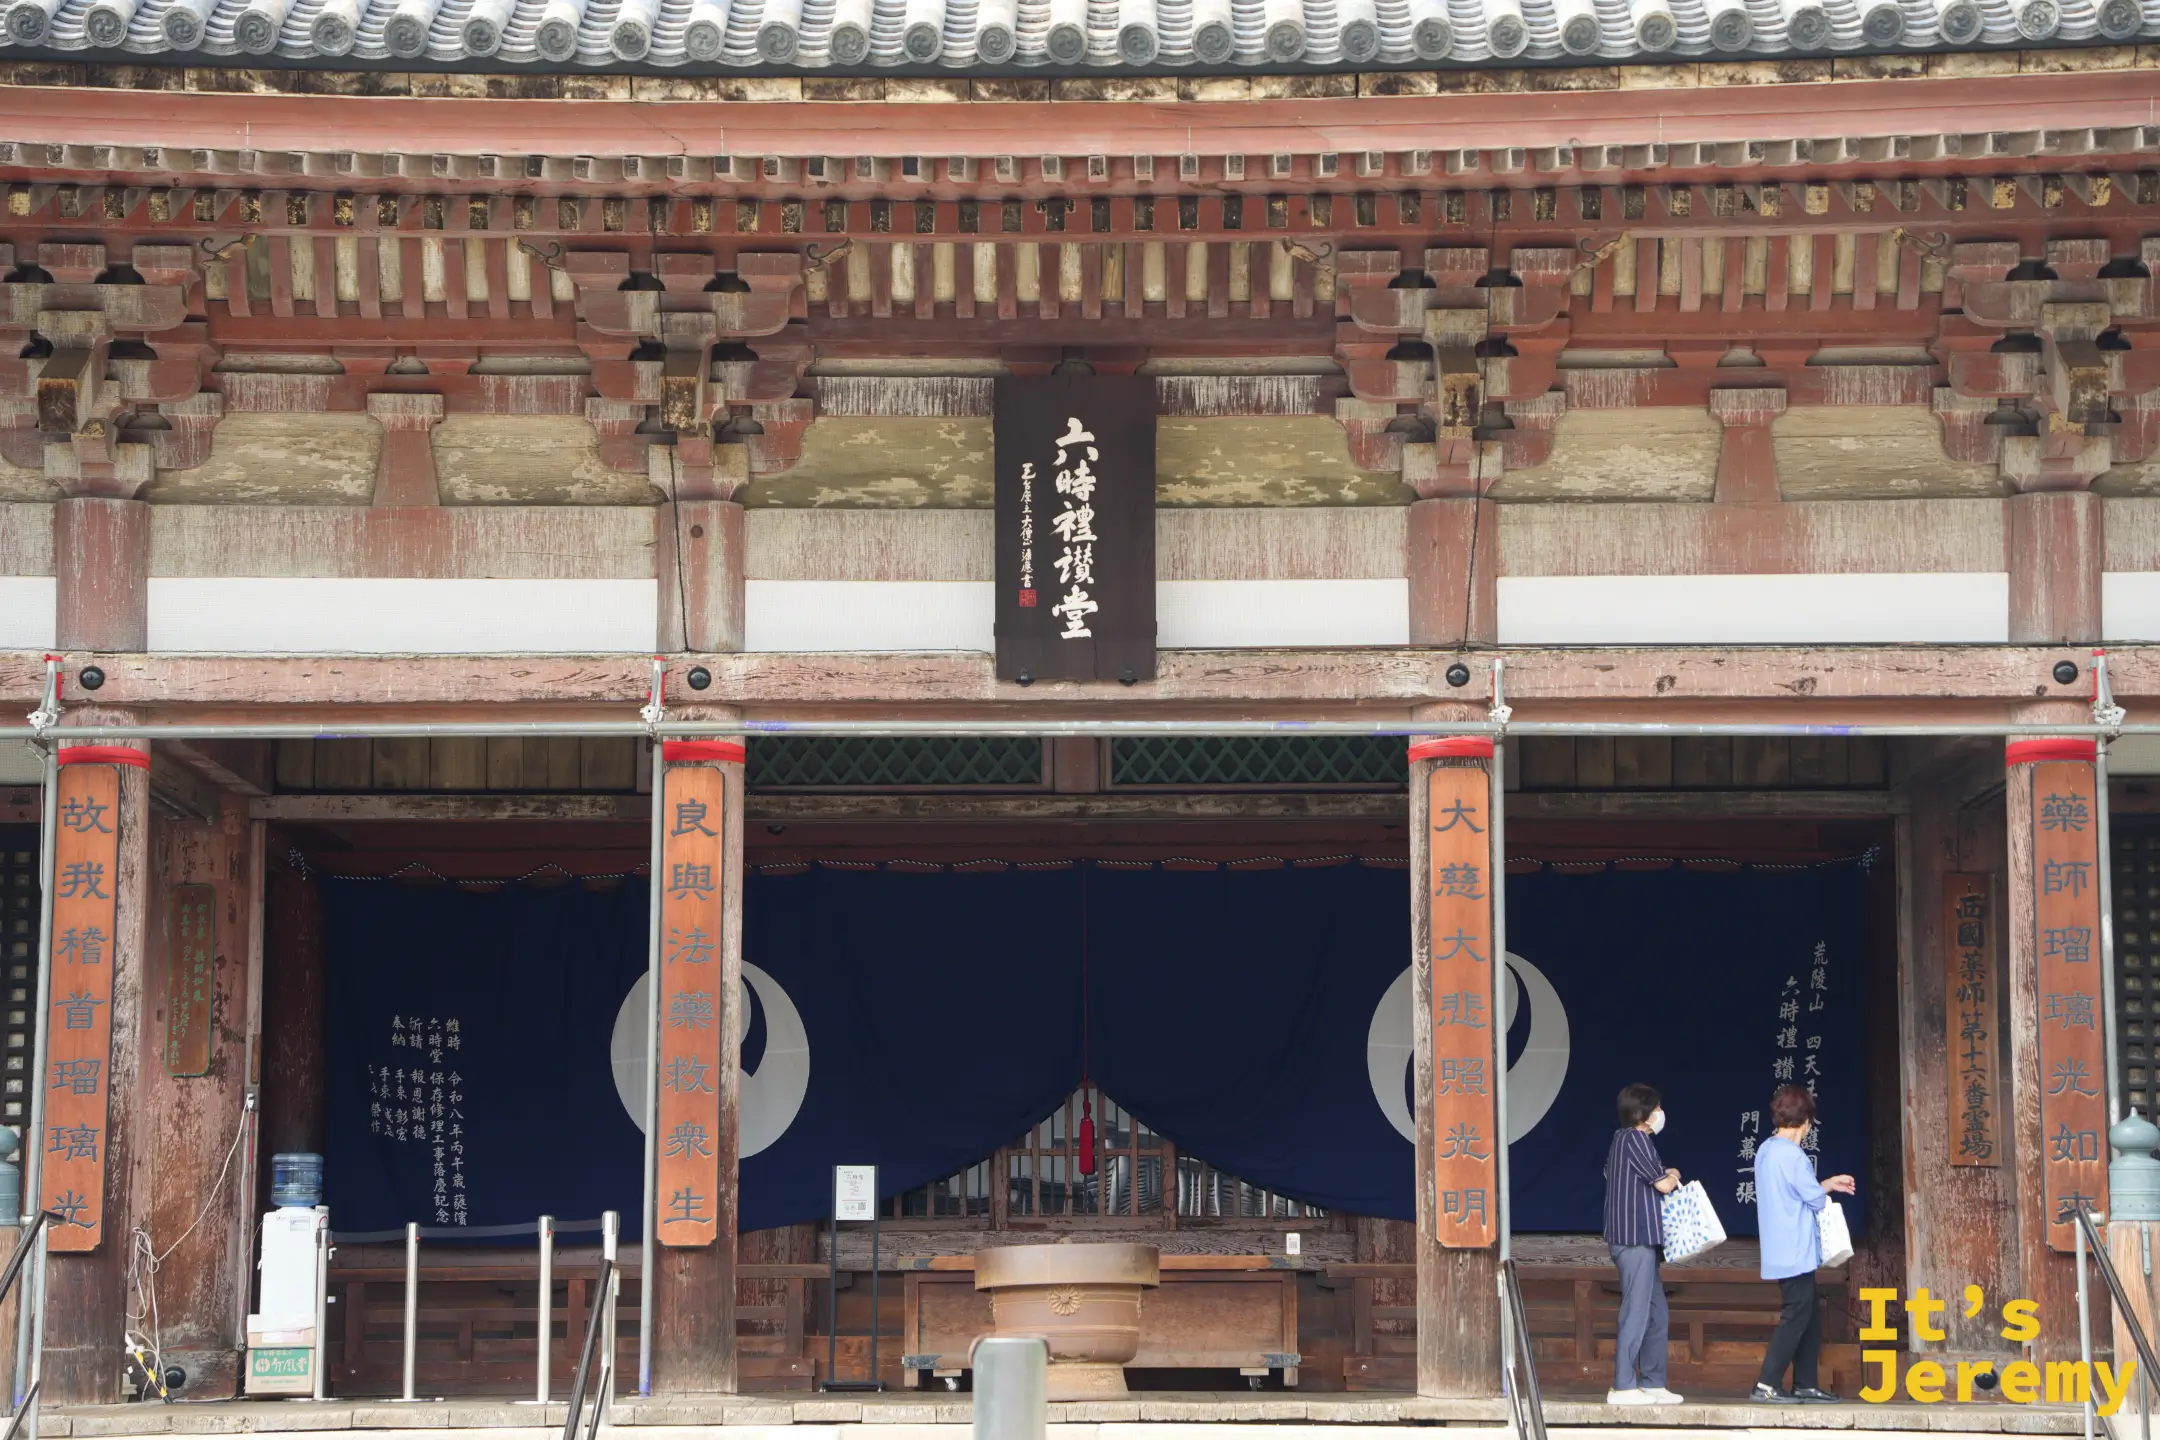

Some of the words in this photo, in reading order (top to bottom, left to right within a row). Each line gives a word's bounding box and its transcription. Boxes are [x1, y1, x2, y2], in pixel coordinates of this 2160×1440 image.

[49, 796, 112, 1229] 故我稽首瑠璃光
[1434, 798, 1490, 1227] 大慈大悲照光明
[1809, 941, 1828, 1011] 荒陵山
[391, 1015, 406, 1047] 奉納
[428, 1017, 443, 1064] 六時堂
[430, 1071, 450, 1224] 保存修理工事落慶記念
[1736, 1110, 1759, 1204] 門幕一張
